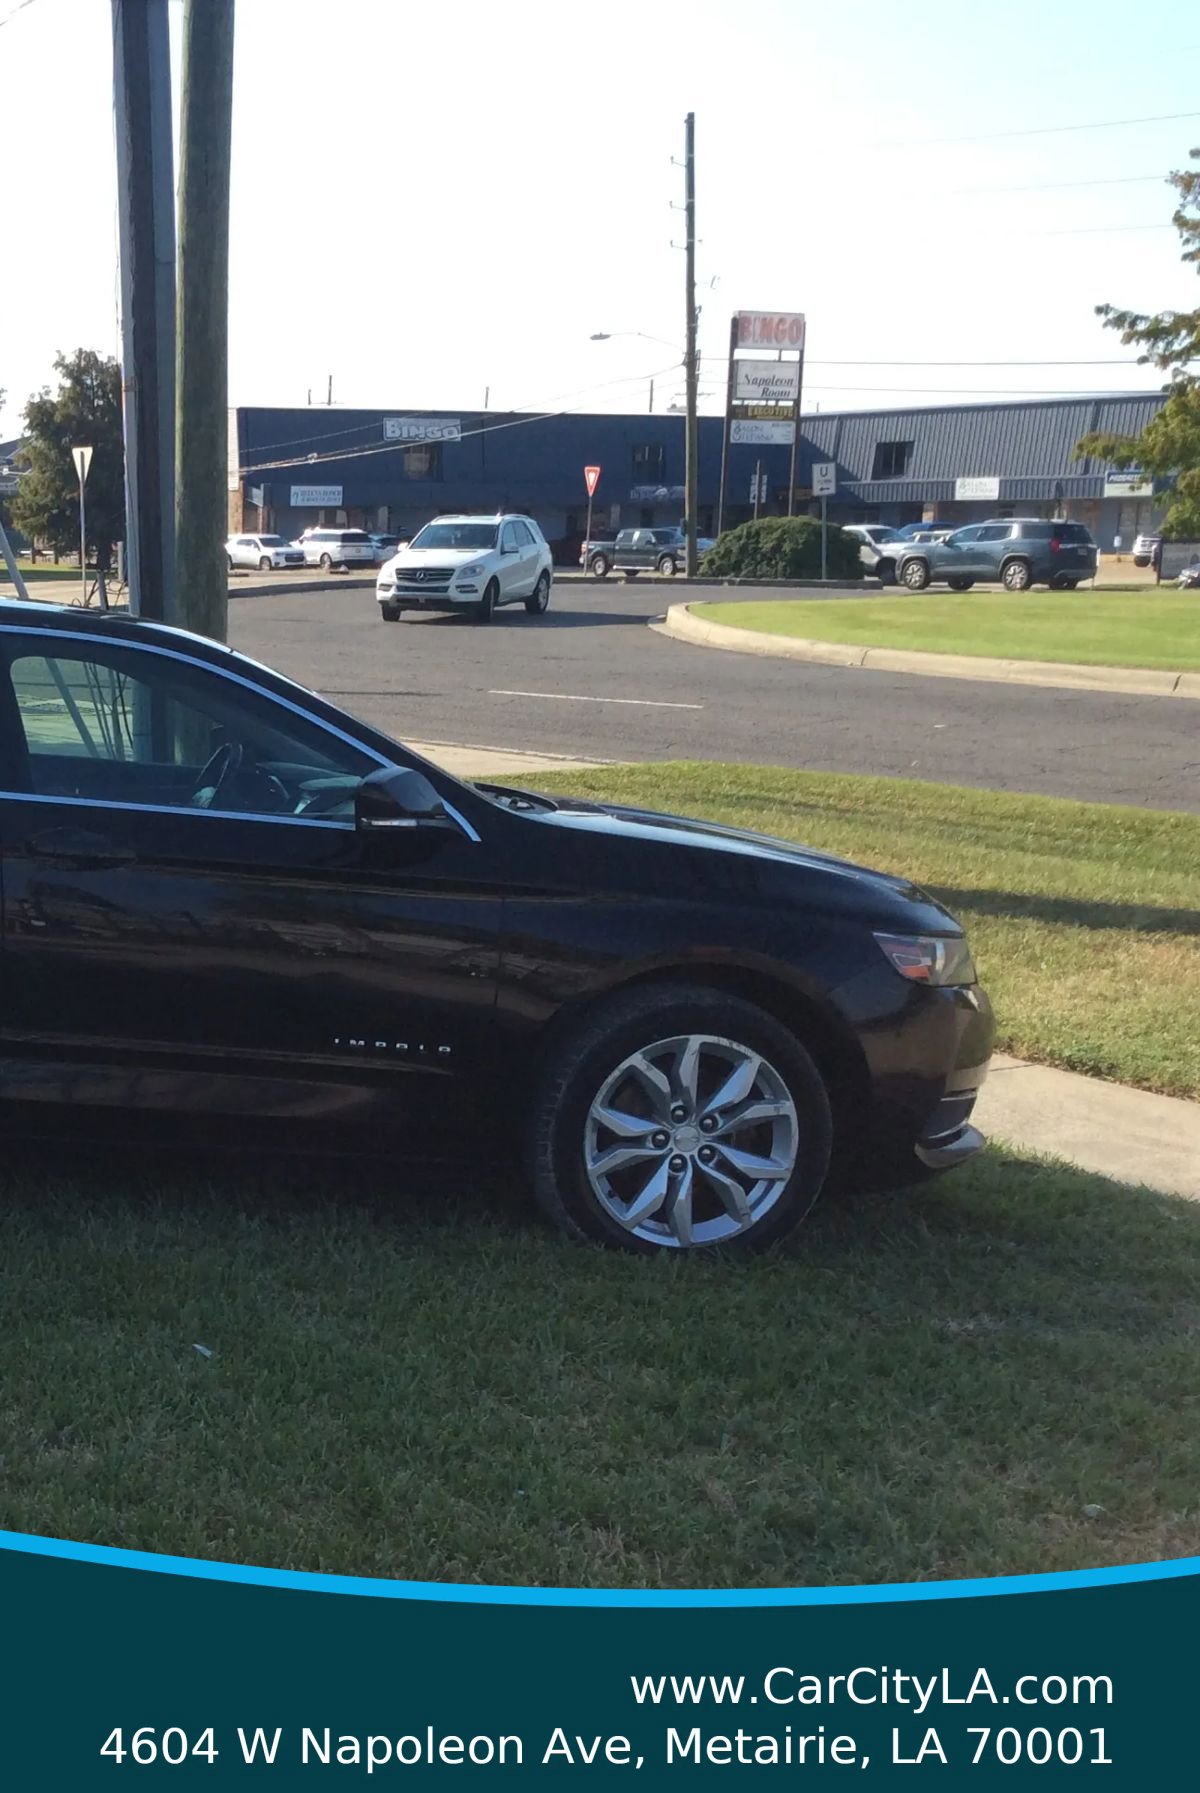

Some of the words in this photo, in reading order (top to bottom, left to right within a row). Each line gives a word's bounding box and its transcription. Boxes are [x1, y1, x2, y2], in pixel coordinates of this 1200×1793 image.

[739, 315, 802, 345] BINGO
[743, 373, 794, 388] Napoleon
[761, 387, 791, 398] Room
[747, 405, 794, 417] EXECUTIVE
[385, 420, 459, 440] BINGO
